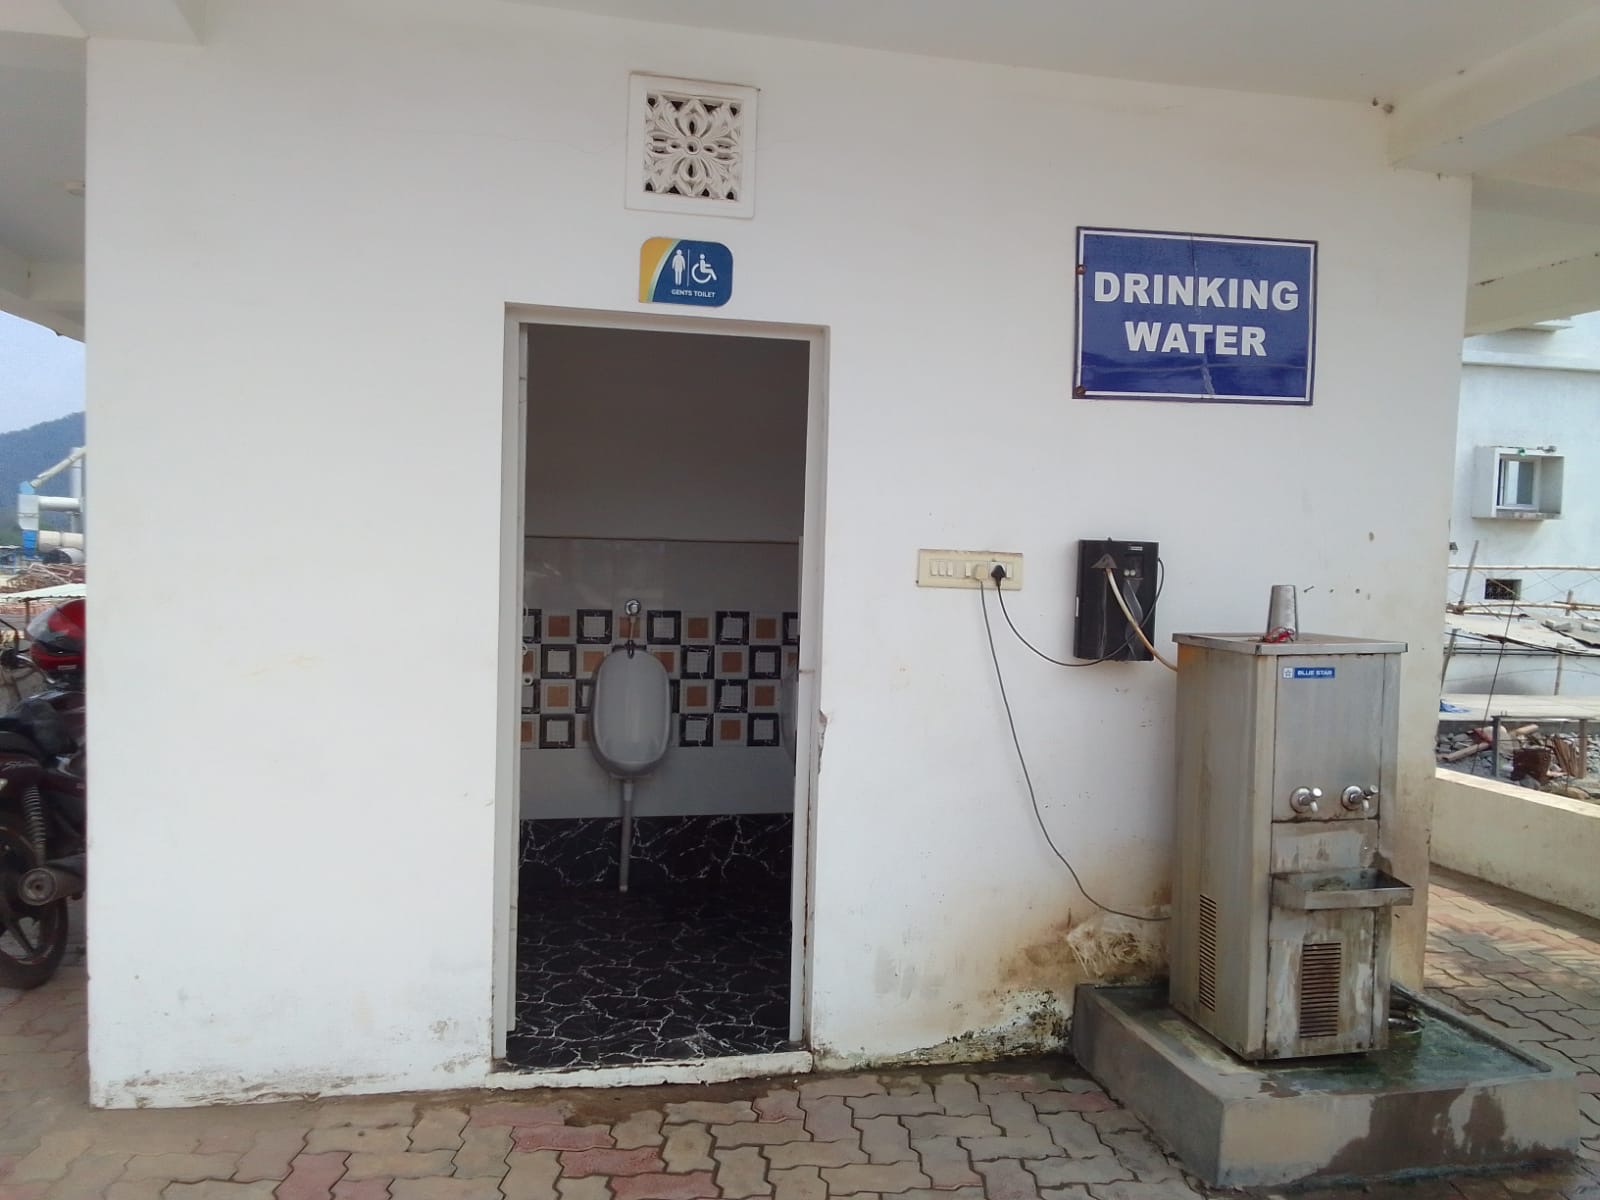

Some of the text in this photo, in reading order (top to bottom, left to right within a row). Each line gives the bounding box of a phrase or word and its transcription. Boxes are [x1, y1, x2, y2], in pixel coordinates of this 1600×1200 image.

[694, 290, 716, 298] TOILET
[1094, 271, 1299, 311] DRINKING
[1124, 321, 1267, 356] WATER
